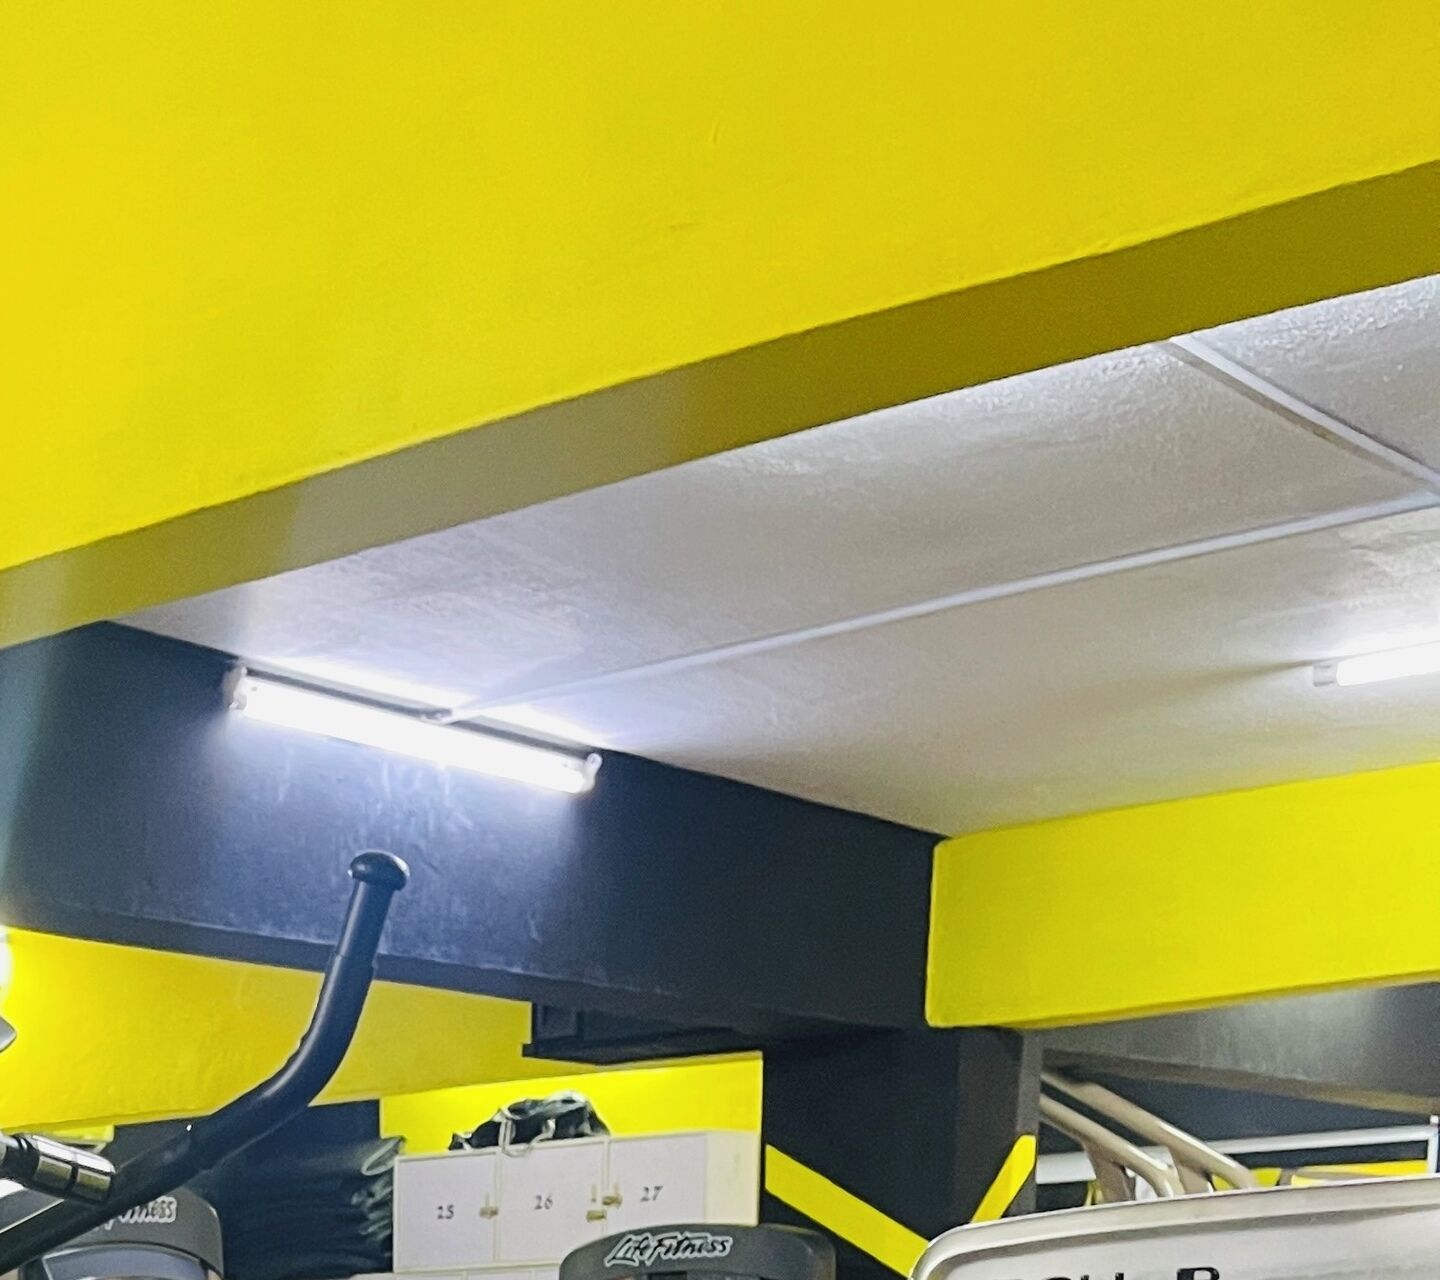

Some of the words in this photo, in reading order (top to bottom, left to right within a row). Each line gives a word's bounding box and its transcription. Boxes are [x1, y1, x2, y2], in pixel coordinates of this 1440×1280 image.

[640, 1185, 664, 1202] 27
[533, 1194, 554, 1211] 26
[436, 1204, 456, 1220] 25
